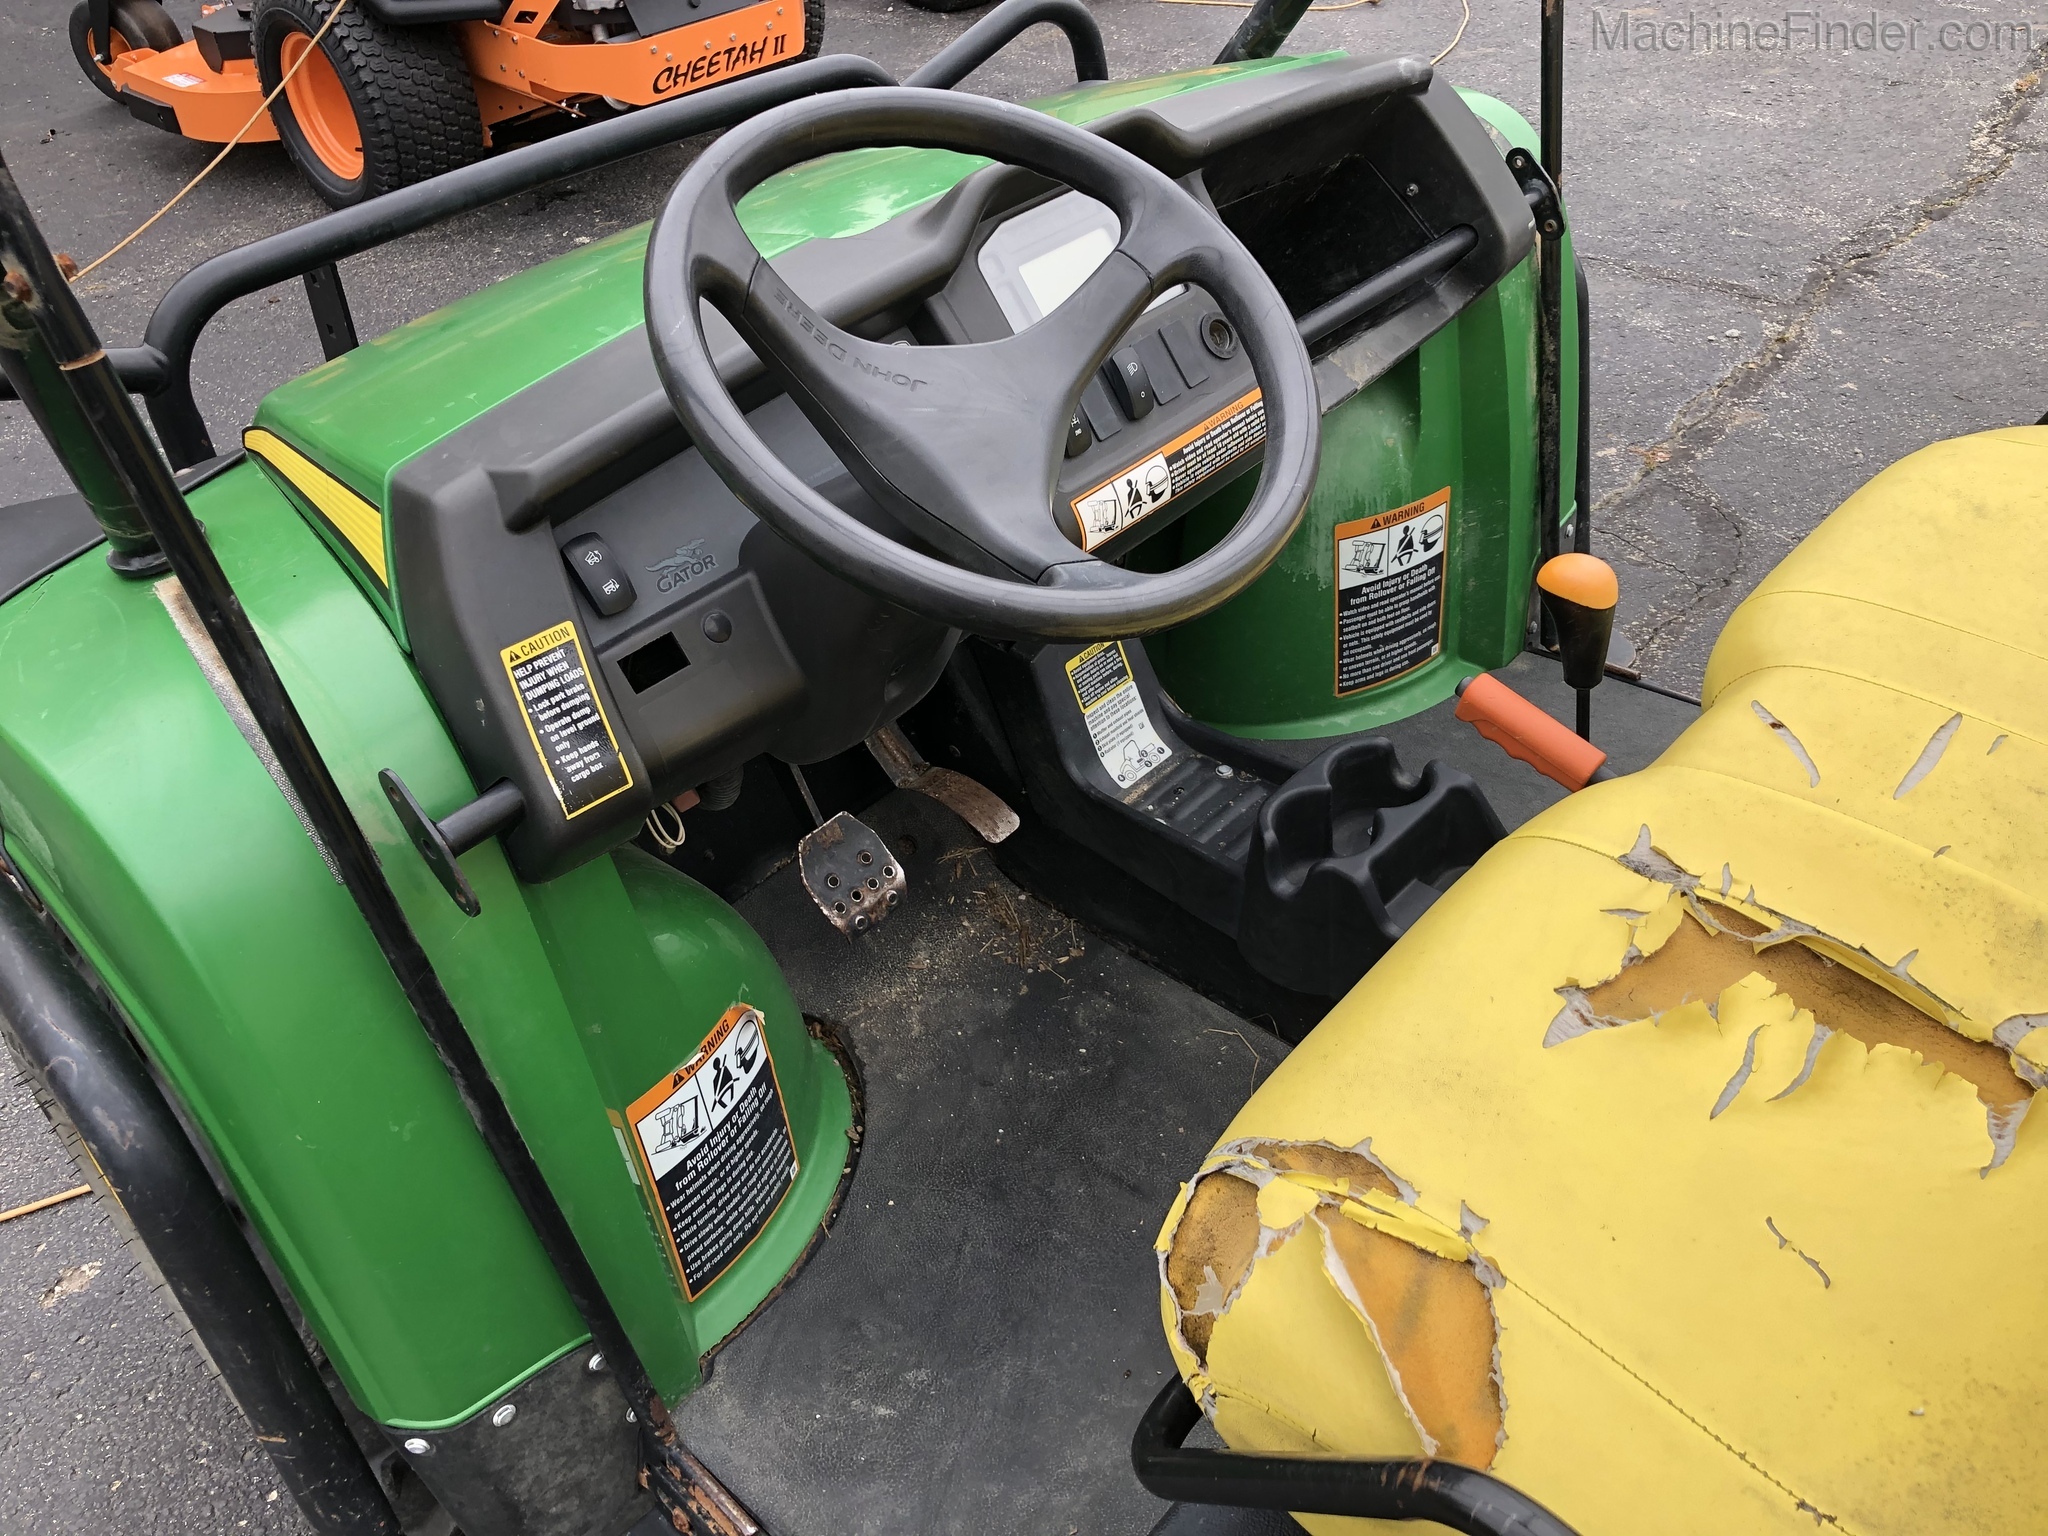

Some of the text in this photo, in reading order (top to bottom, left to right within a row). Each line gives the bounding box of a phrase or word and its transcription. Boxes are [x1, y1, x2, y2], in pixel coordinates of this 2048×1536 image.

[653, 34, 787, 94] CHEETAH II
[774, 287, 928, 393] JOHN DEERE
[1209, 402, 1244, 428] WARNING
[1383, 502, 1425, 526] WARNING
[656, 554, 716, 594] GATOR
[1350, 565, 1435, 605] from Rollover or Falling Off
[1361, 562, 1427, 594] Avoid Injury or Death
[519, 625, 570, 656] CAUTION
[1083, 643, 1105, 659] CAUTION
[512, 648, 566, 679] HELP PREVENT
[518, 659, 569, 690] INJURY WHEN
[524, 666, 584, 701] DUMPING LOADS
[532, 681, 585, 712] Lock park brake
[537, 690, 590, 721] before dumping
[544, 704, 591, 734] Operate dump
[1084, 707, 1099, 720] Inspect
[1098, 702, 1106, 710] and
[1105, 695, 1116, 705] clean
[1087, 711, 1103, 725] machine
[1117, 692, 1130, 705] special
[1089, 716, 1105, 731] attention
[1109, 707, 1119, 717] these
[549, 712, 600, 742] on level ground
[554, 739, 571, 754] only
[560, 738, 599, 765] Keep hands
[565, 750, 600, 774] away from
[570, 760, 603, 784] cargo box
[675, 1080, 767, 1191] from Rollover or Falling Off
[684, 1084, 757, 1170] Avoid Injury or Death
[670, 1192, 686, 1208] Wear
[685, 1172, 707, 1196] helmets
[706, 1159, 720, 1176] when
[719, 1140, 736, 1164] driving
[734, 1108, 760, 1147] aggressively,
[673, 1210, 681, 1219] or
[680, 1193, 701, 1213] uneven
[700, 1173, 719, 1196] terrain,
[719, 1168, 725, 1178] or
[724, 1161, 730, 1172] at
[729, 1145, 744, 1167] higher
[676, 1214, 692, 1231] Keep
[691, 1201, 706, 1217] arms
[705, 1191, 716, 1205] and
[715, 1179, 727, 1196] legs
[726, 1174, 732, 1184] in
[731, 1157, 746, 1180] during
[680, 1222, 697, 1240] While
[696, 1203, 718, 1227] turning,
[717, 1190, 730, 1207] drive
[729, 1177, 741, 1194] slow
[740, 1167, 749, 1182] and
[748, 1160, 754, 1172] do
[753, 1151, 761, 1165] not
[683, 1234, 698, 1250] Drive
[696, 1220, 714, 1240] slowly
[713, 1208, 726, 1224] when
[725, 1190, 742, 1212] loaded,
[741, 1184, 747, 1195] on
[746, 1170, 758, 1190] rough
[757, 1165, 762, 1175] or
[686, 1242, 704, 1262] paved
[702, 1221, 725, 1247] surfaces,
[724, 1208, 738, 1226] while
[737, 1185, 757, 1214] operating
[756, 1179, 761, 1190] at
[760, 1166, 771, 1185] night
[689, 1257, 701, 1271] Use
[700, 1241, 718, 1261] brakes
[717, 1227, 733, 1247] going
[732, 1214, 744, 1232] down
[754, 1181, 769, 1206] Vehicle
[692, 1268, 703, 1281] For
[702, 1249, 723, 1272] off-road
[723, 1241, 732, 1254] use
[732, 1227, 744, 1246] only.
[743, 1219, 751, 1232] Do
[750, 1211, 758, 1224] not
[757, 1202, 765, 1215] use
[764, 1195, 770, 1206] on
